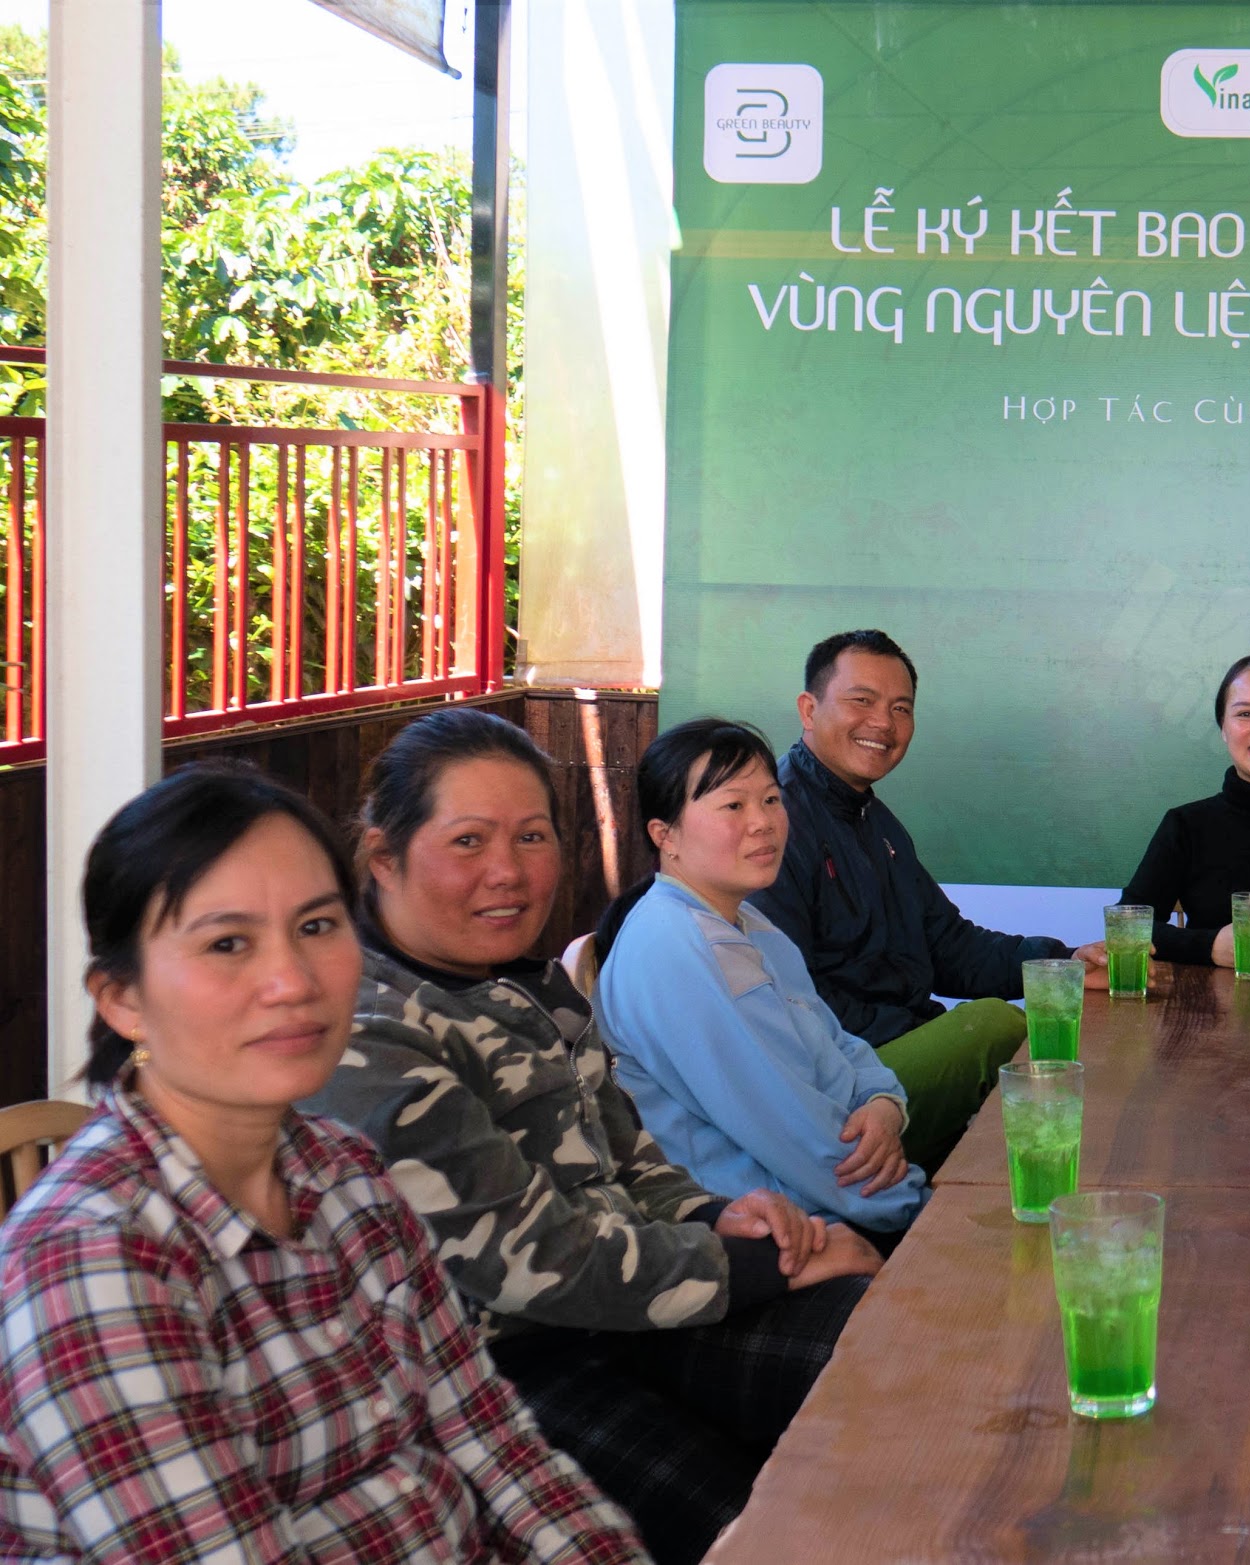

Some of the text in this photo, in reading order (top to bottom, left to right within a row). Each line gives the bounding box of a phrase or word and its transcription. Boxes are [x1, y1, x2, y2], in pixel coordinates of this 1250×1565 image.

[716, 118, 811, 131] GREEN BEAUTY
[830, 187, 895, 253] LỄ
[916, 196, 989, 255] KÝ
[1011, 187, 1116, 257] KẾT
[1137, 211, 1245, 258] BAO
[747, 271, 903, 344] VÙNG
[926, 276, 1152, 346] NGUYÊN
[1003, 395, 1076, 425] HỢP
[1098, 394, 1173, 423] TÁC
